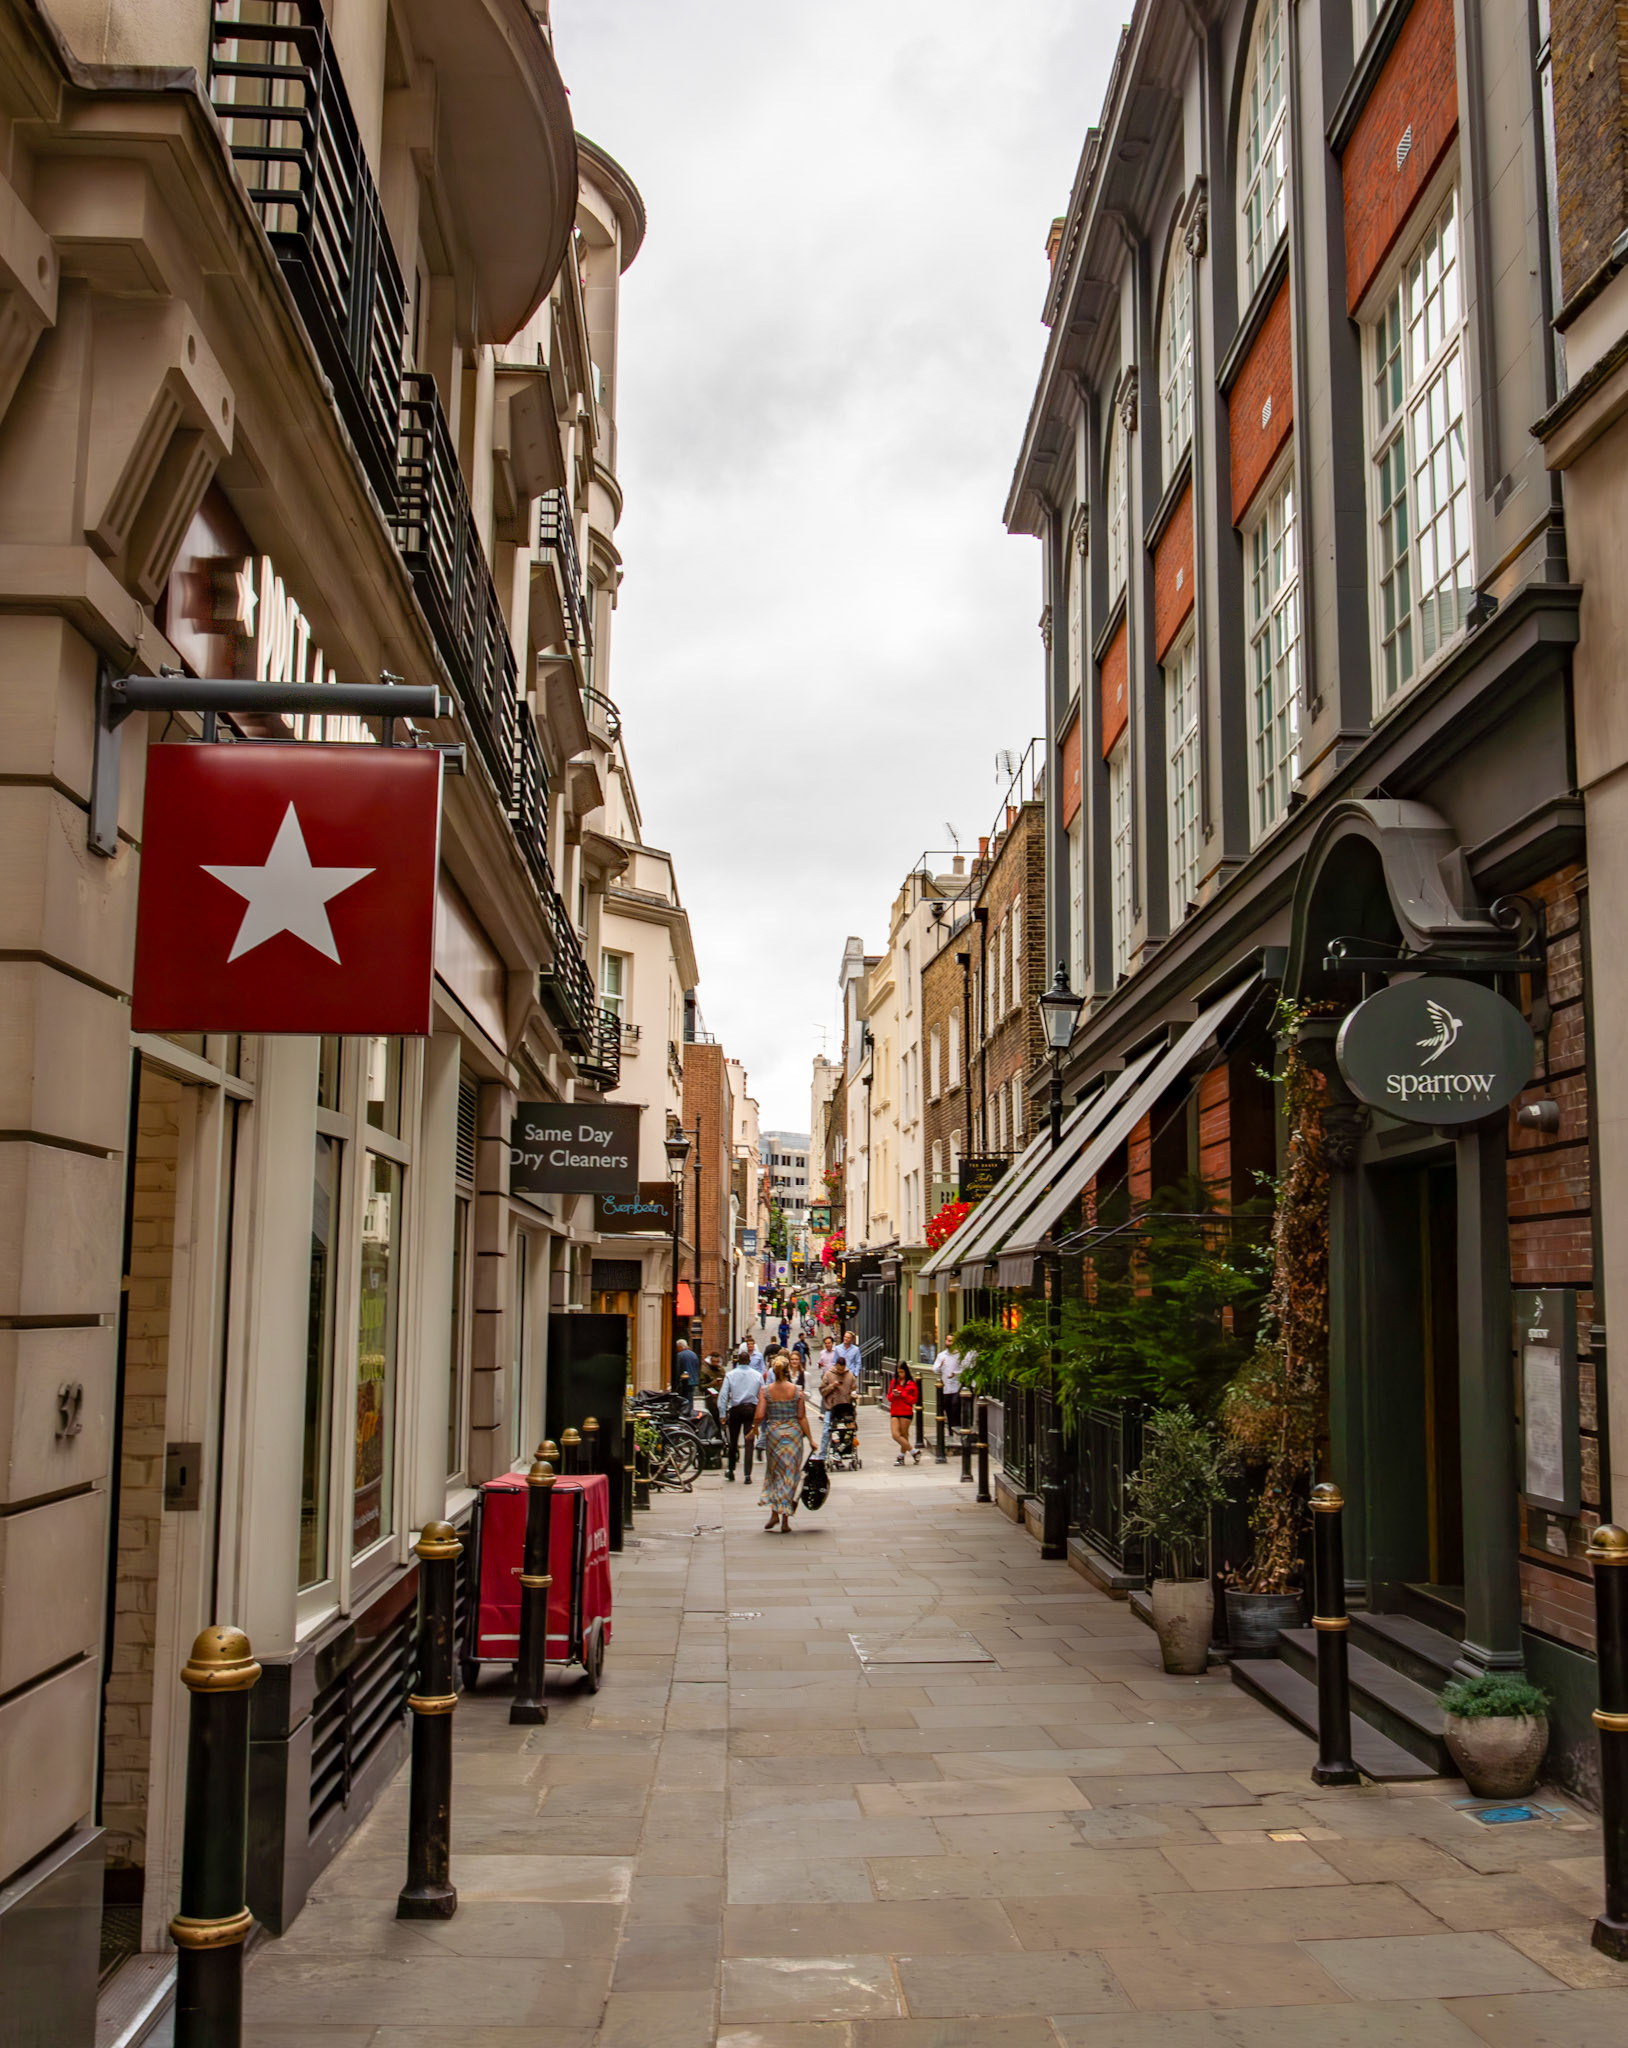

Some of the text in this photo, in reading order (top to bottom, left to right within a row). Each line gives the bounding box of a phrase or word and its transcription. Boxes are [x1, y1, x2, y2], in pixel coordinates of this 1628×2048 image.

[1386, 1074, 1496, 1101] sparrow
[524, 1123, 613, 1148] Same Day
[510, 1148, 628, 1171] Dry Cleaners
[602, 1195, 669, 1217] Everbean
[57, 1381, 83, 1437] 32
